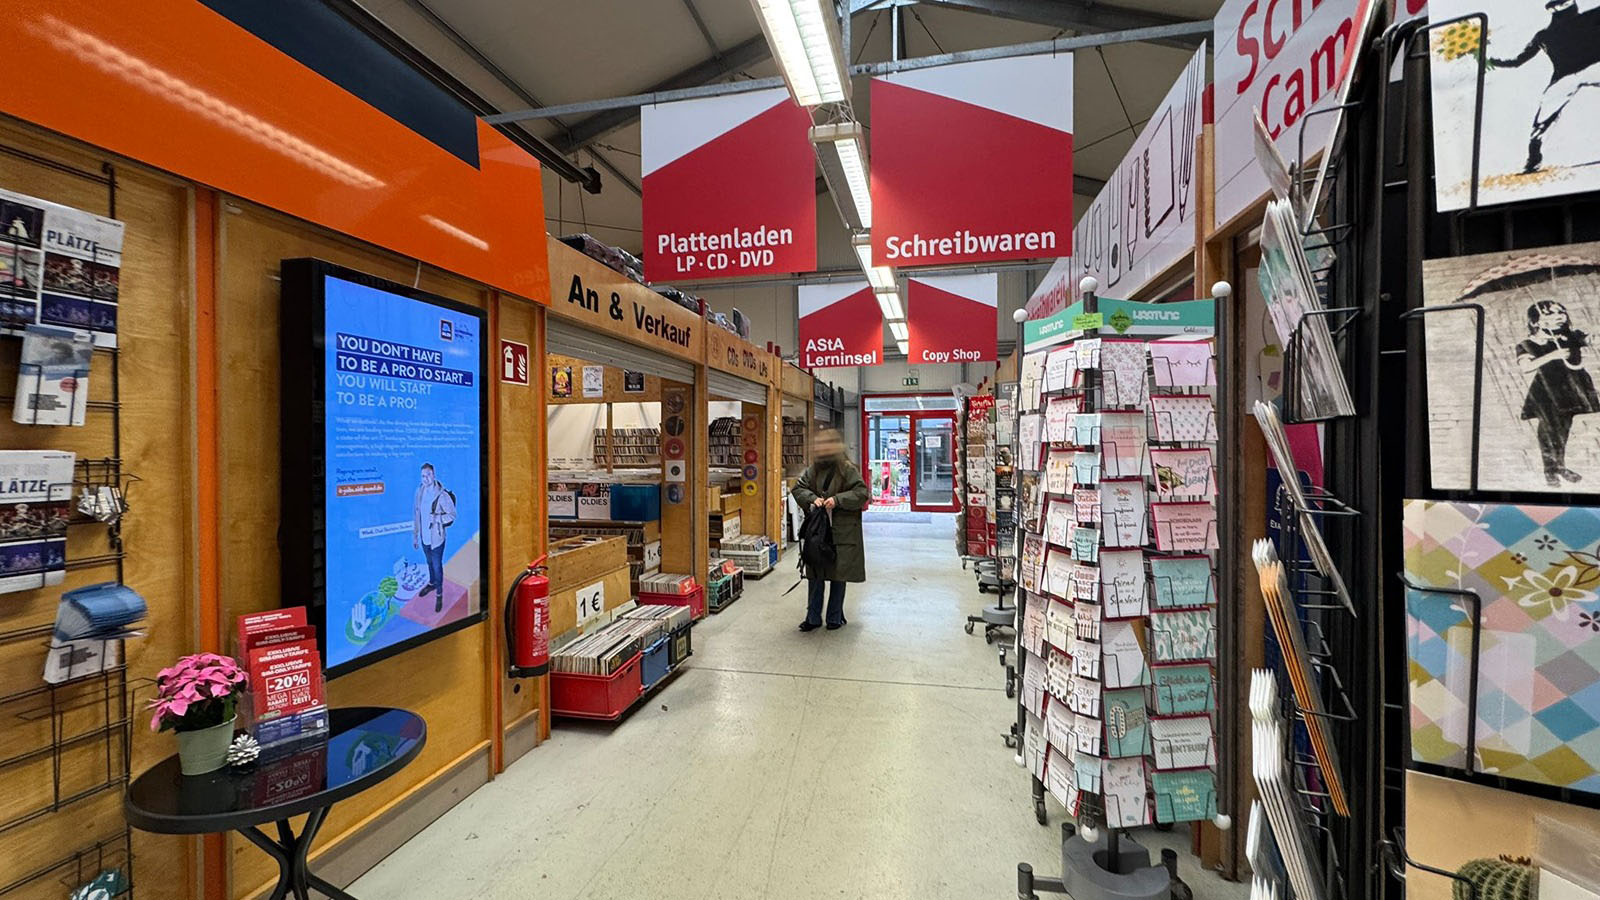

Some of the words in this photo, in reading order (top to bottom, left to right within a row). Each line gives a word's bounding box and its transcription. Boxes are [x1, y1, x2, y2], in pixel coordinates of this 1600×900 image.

[1261, 17, 1353, 141] Cam
[658, 225, 793, 254] Plattenladen
[886, 230, 1056, 259] Schreibwaren
[677, 255, 696, 272] LP
[707, 253, 728, 270] CD
[740, 249, 774, 268] DVD
[568, 274, 599, 313] An
[609, 292, 623, 321] &
[633, 302, 691, 348] Verkauf
[338, 335, 368, 350] YOU
[371, 341, 410, 359] DON'T
[412, 349, 440, 364] HAVE
[805, 338, 844, 352] AStA
[922, 349, 949, 363] Copy
[952, 348, 981, 362] Shop
[338, 355, 357, 370] TO
[361, 359, 377, 373] BE
[380, 362, 389, 375] A
[392, 363, 416, 377] PRO
[418, 367, 432, 380] TO
[434, 370, 464, 384] START
[727, 346, 739, 367] CDs
[742, 349, 756, 370] DVDs
[759, 360, 768, 378] LPs
[806, 350, 876, 367] Lerninsel
[336, 373, 366, 388] YOU
[369, 377, 397, 392] WILL
[400, 381, 432, 395] START
[336, 392, 355, 405] TO
[358, 393, 375, 407] BE
[377, 395, 388, 408] A
[390, 396, 417, 409] PRO!
[581, 498, 608, 506] OLDIES
[580, 597, 587, 618] 1
[592, 591, 601, 612] €
[268, 673, 307, 691] -20%
